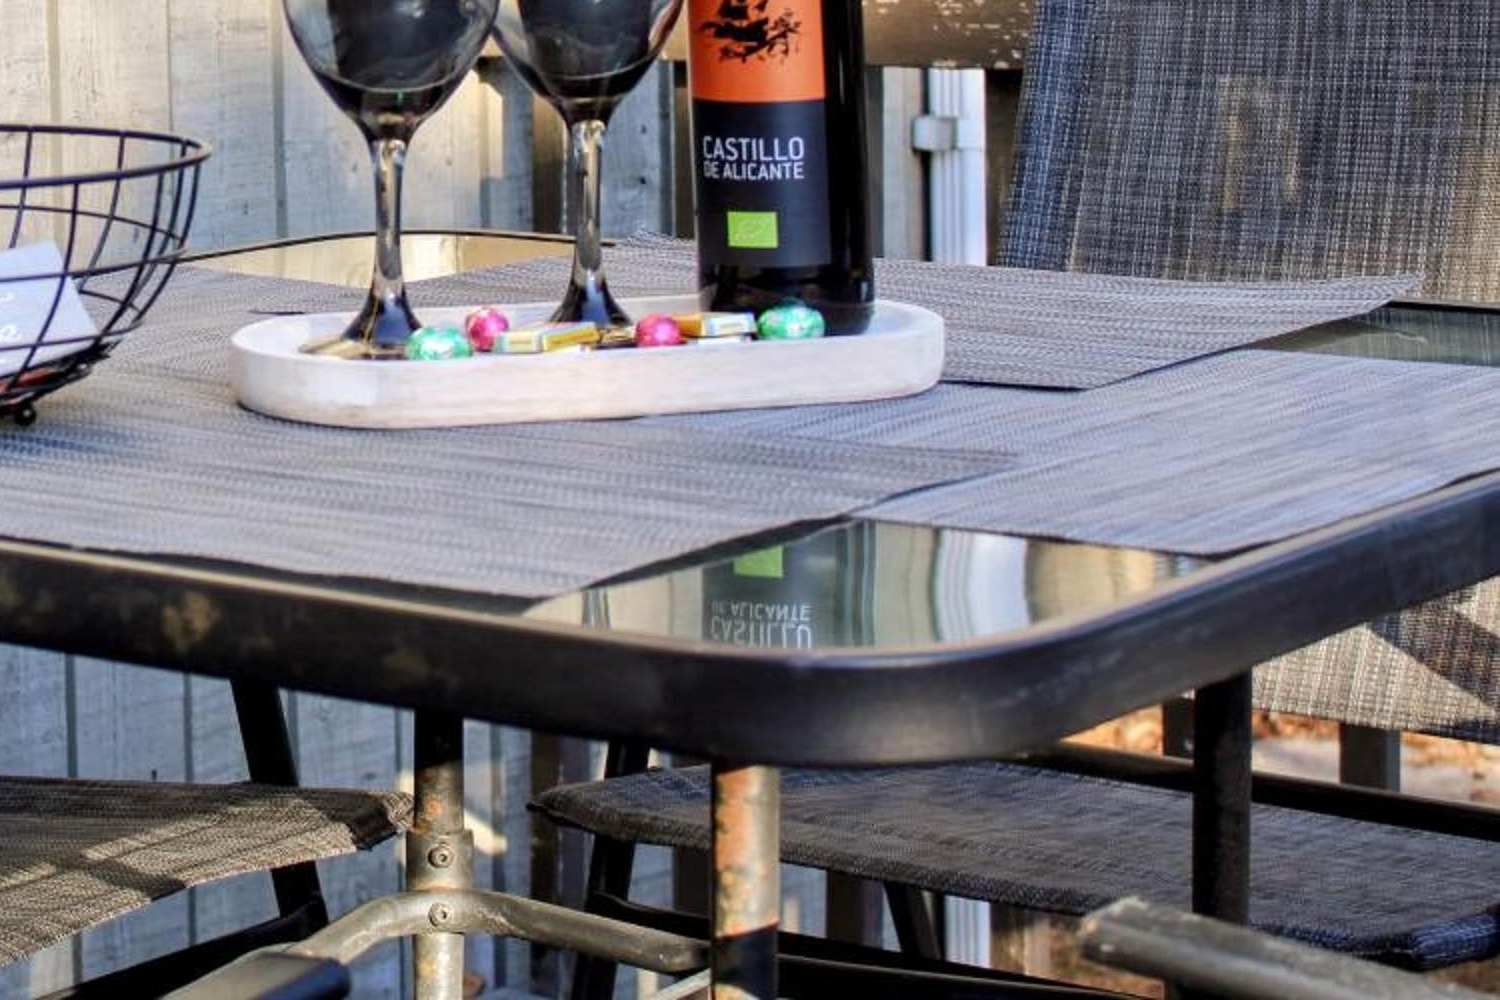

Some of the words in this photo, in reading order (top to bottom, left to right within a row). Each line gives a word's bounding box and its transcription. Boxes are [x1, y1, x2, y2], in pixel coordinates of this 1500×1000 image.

[702, 135, 805, 161] CASTILLO
[703, 160, 720, 179] DE
[723, 161, 805, 181] ALICANTE
